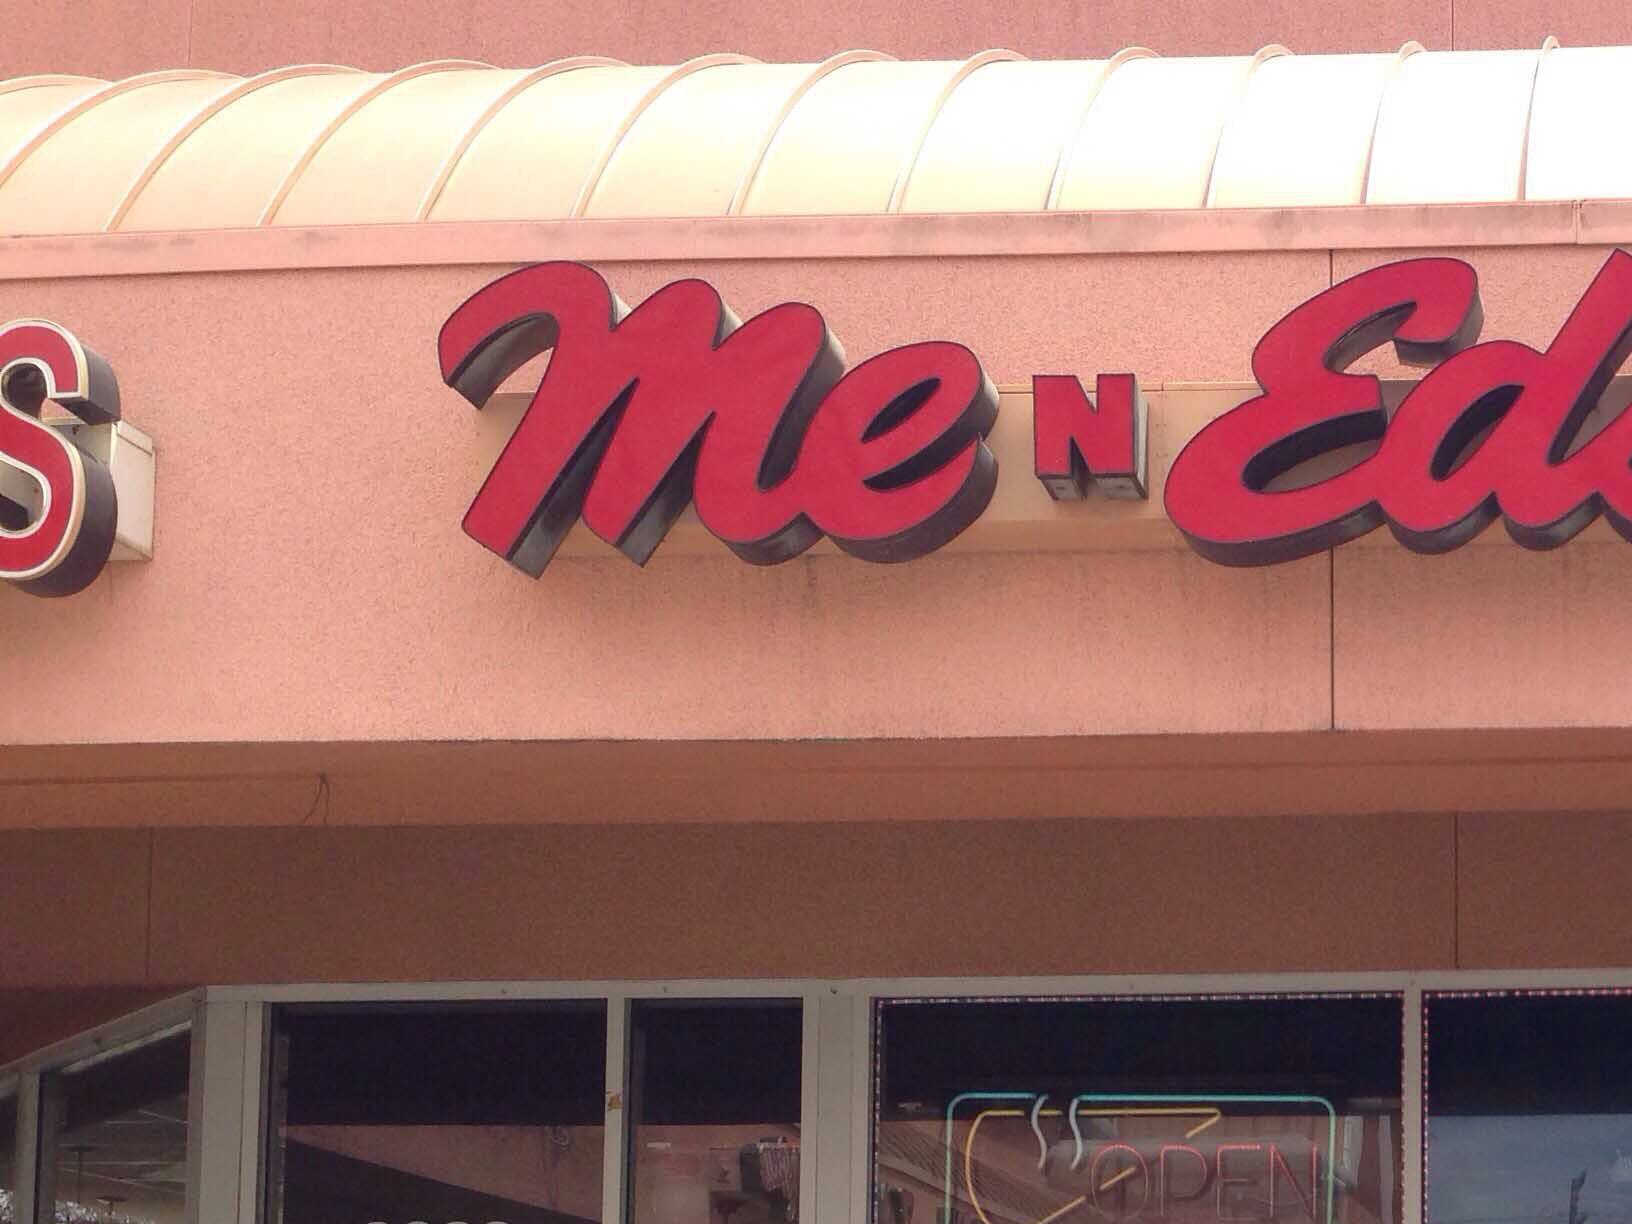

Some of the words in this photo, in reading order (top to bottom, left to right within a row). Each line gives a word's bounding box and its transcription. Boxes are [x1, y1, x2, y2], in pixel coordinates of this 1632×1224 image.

[438, 260, 992, 568] Me
[1033, 373, 1143, 490] N
[1091, 1143, 1319, 1222] OPEN
